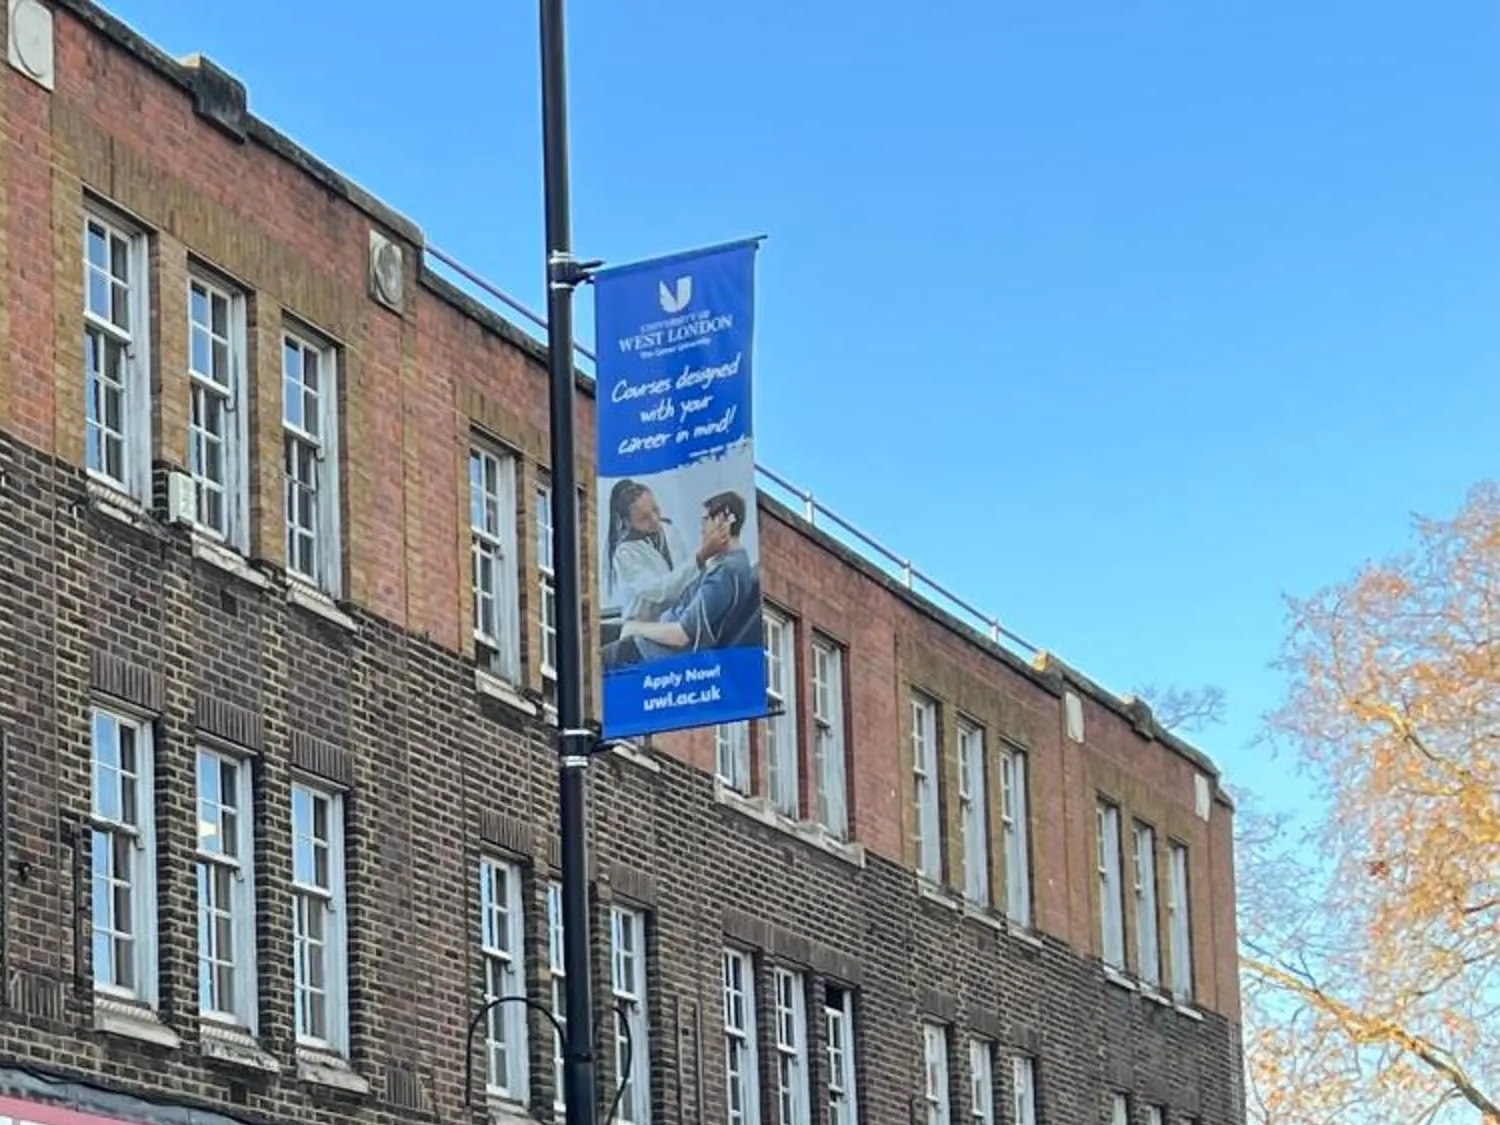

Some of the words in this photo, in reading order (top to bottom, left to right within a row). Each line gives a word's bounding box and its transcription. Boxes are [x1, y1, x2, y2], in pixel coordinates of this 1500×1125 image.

[619, 332, 663, 353] WEST
[667, 314, 734, 343] LONDON
[612, 379, 672, 403] Courses
[676, 352, 741, 390] designed
[640, 397, 675, 422] with
[680, 396, 714, 423] your
[618, 432, 671, 455] career
[676, 426, 690, 443] in
[694, 404, 738, 438] mind!
[643, 671, 683, 690] Apply
[685, 664, 722, 683] Now!
[643, 685, 722, 711] uwl.ac.uk
